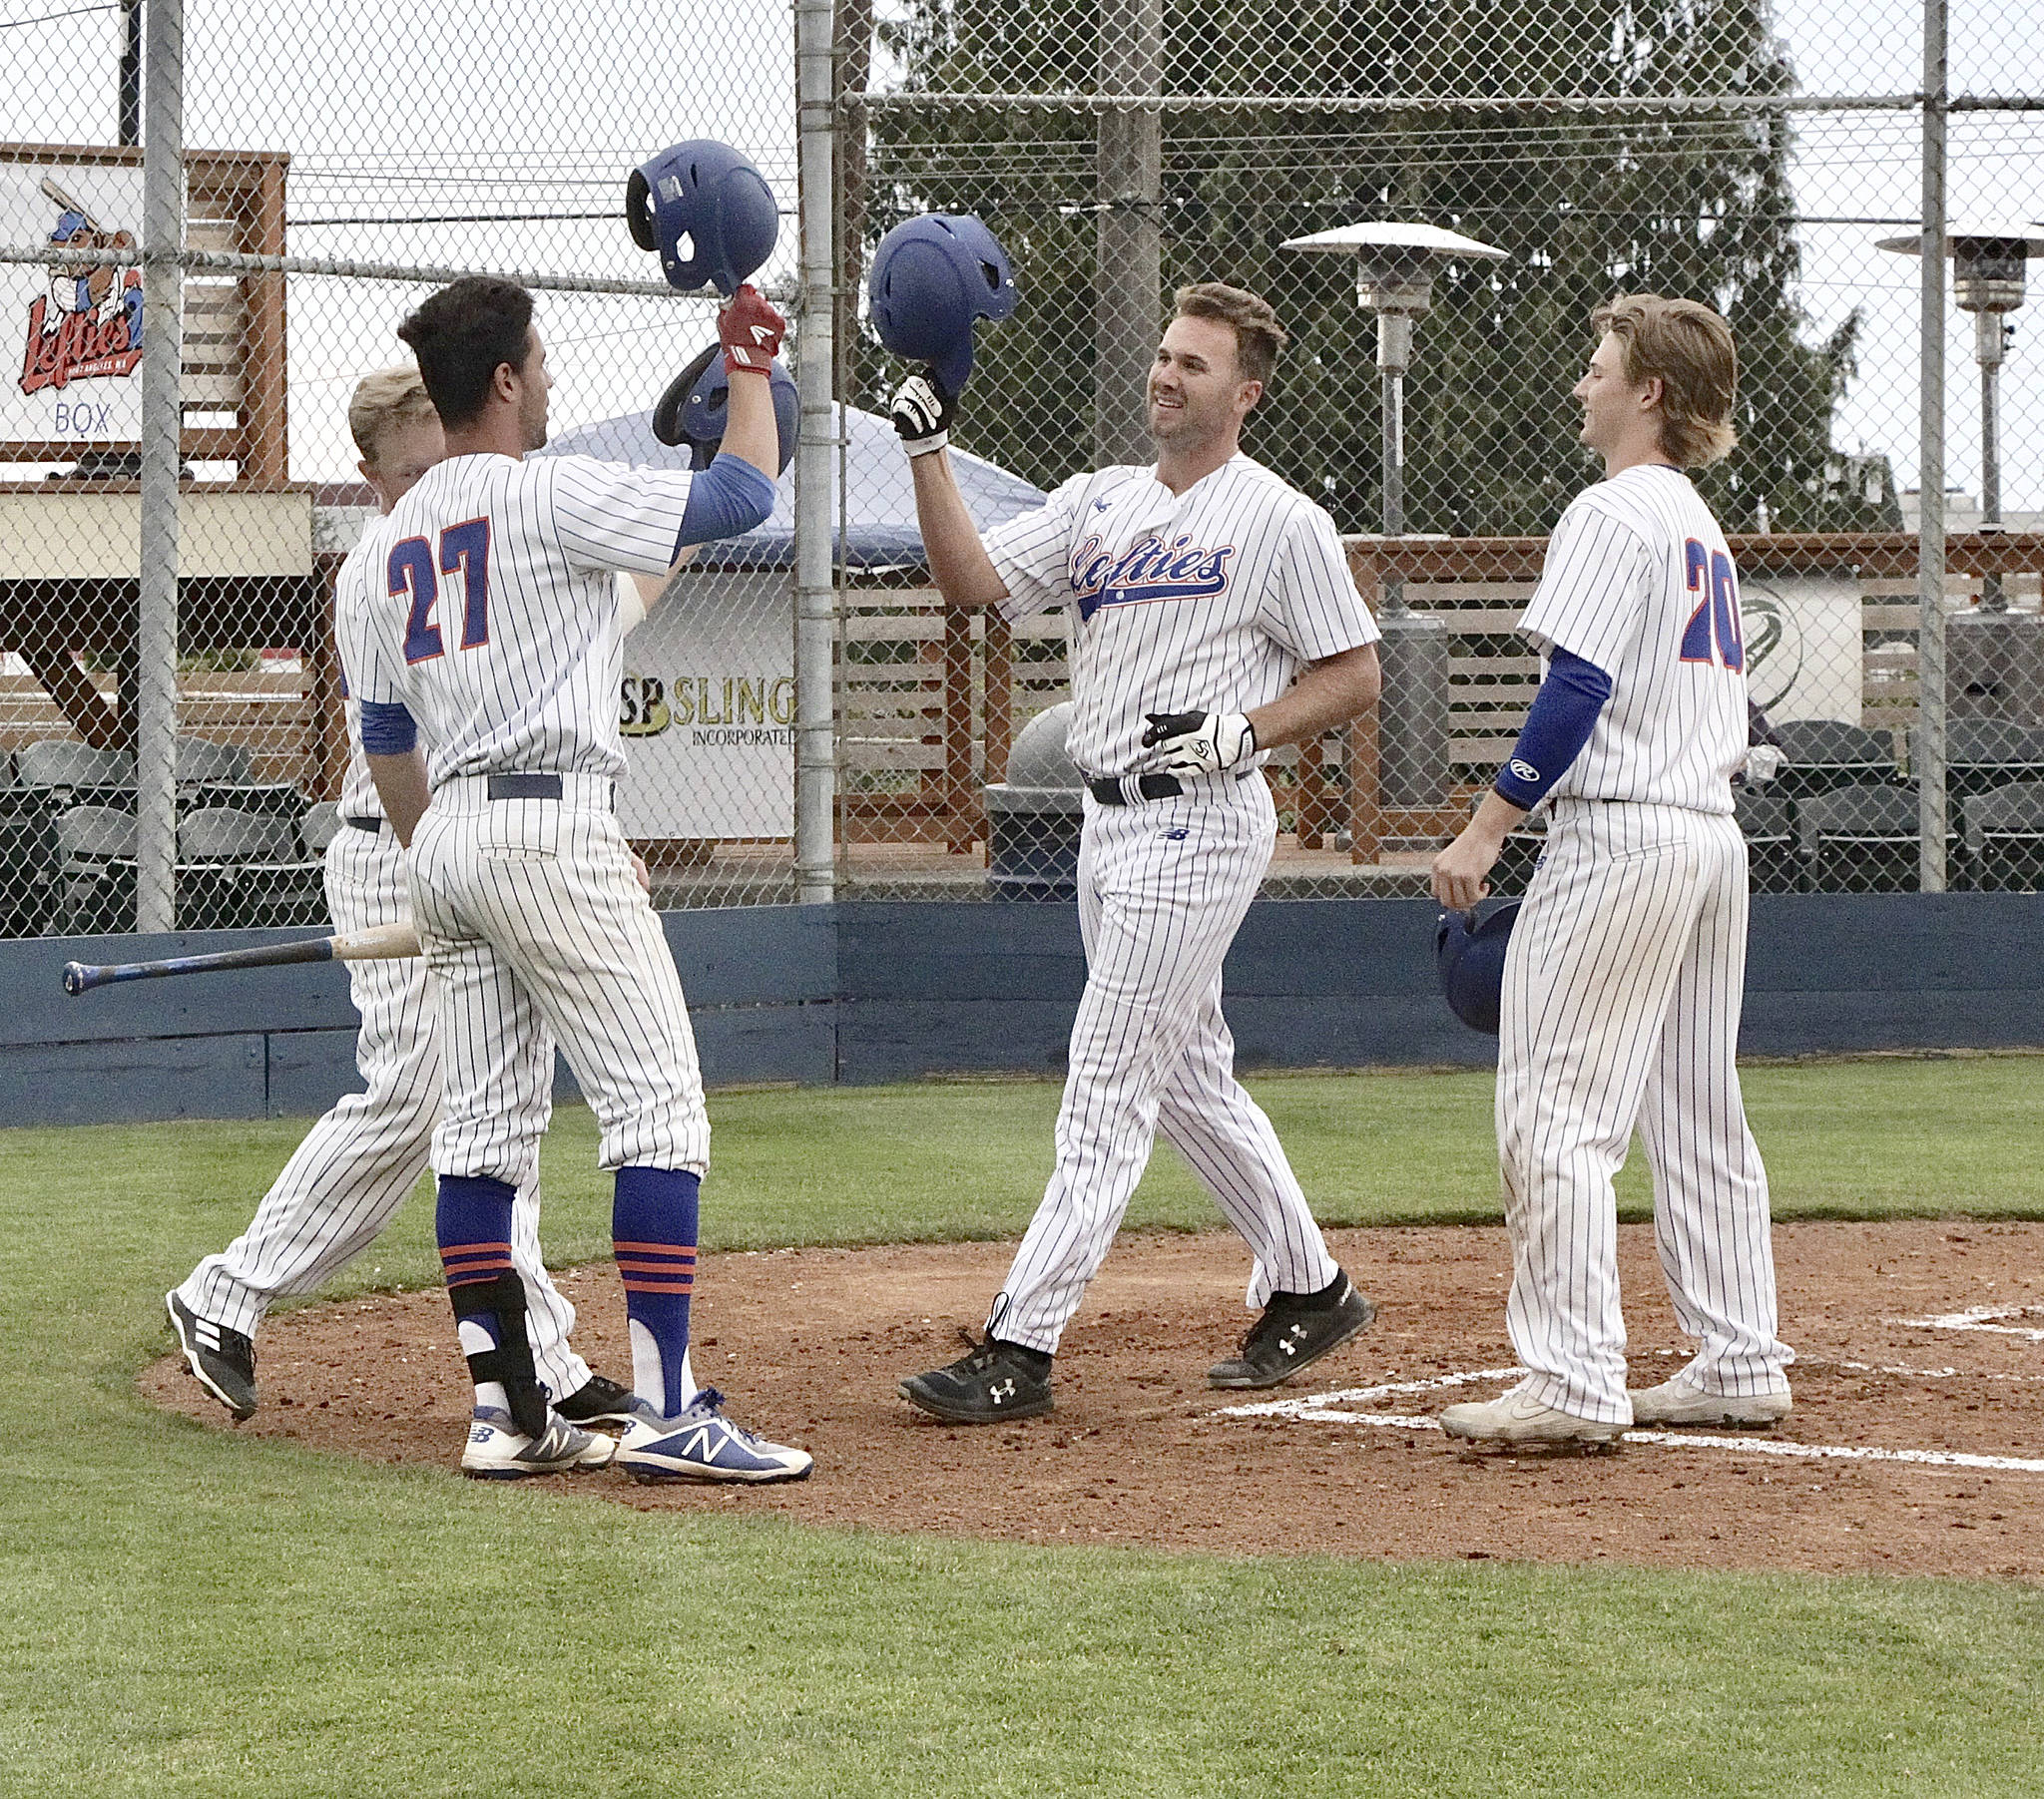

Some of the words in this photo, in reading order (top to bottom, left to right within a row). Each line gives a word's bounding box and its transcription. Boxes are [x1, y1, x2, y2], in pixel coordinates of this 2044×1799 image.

[18, 294, 132, 396] Lefties
[55, 402, 111, 433] BOX
[387, 516, 490, 666] 27
[1070, 533, 1236, 599] Lefties
[1679, 537, 1745, 675] 20
[673, 675, 798, 725] SLING
[681, 1427, 730, 1463] N
